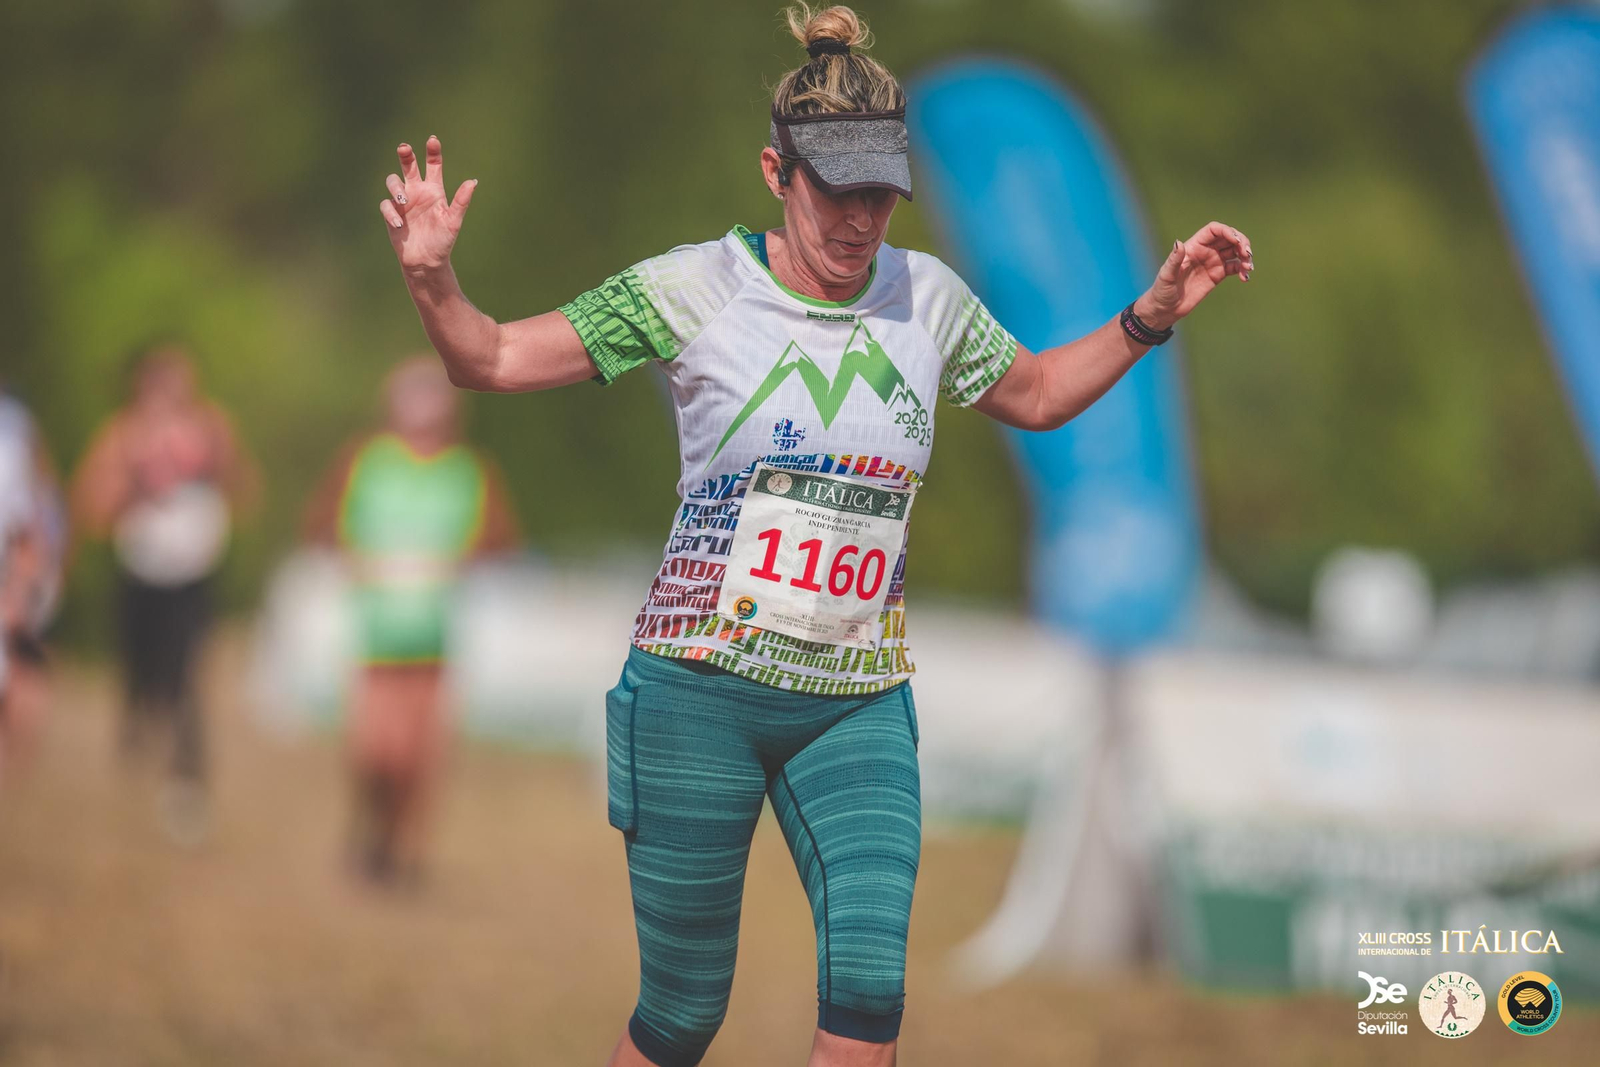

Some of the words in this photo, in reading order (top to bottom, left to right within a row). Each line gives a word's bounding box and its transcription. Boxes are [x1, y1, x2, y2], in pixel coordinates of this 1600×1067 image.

[894, 408, 928, 426] 2020
[904, 426, 931, 447] 2025
[803, 480, 874, 510] ITÁLICA
[808, 519, 859, 535] INDEPENDIENTE
[750, 528, 886, 601] 1160
